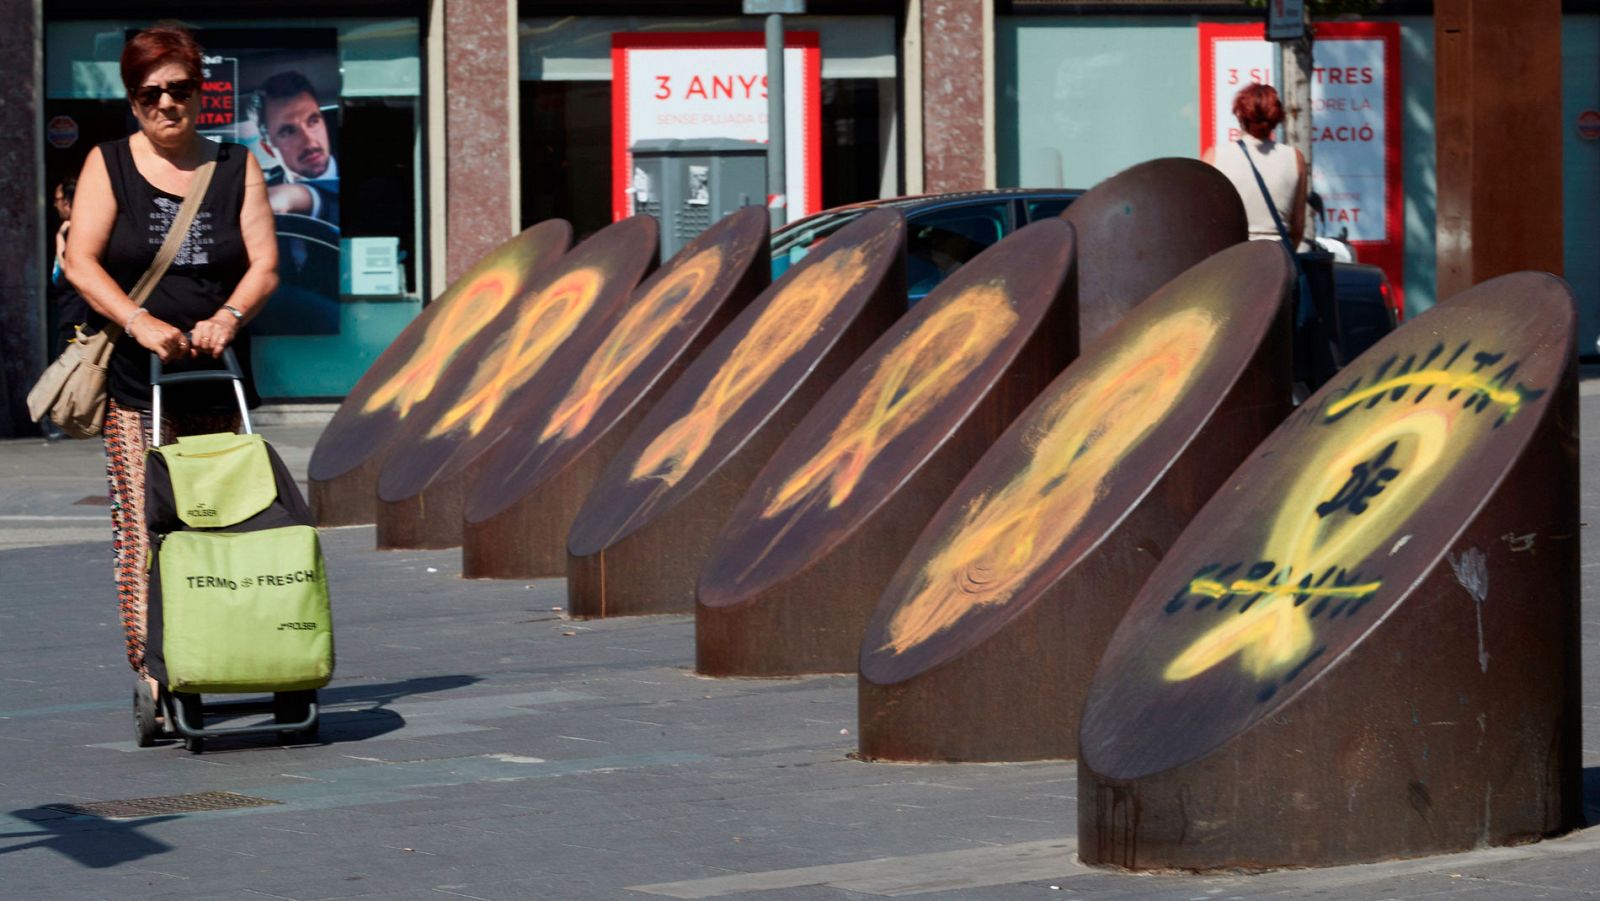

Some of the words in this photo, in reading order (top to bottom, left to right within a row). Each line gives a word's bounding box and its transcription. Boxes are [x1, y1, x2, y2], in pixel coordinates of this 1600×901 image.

[1228, 68, 1239, 85] 3
[655, 75, 672, 100] 3
[201, 95, 233, 109] TXE
[1324, 208, 1361, 223] TAT
[187, 508, 218, 517] ROLSER
[187, 576, 237, 590] TERMO
[286, 622, 317, 631] ROLSER
